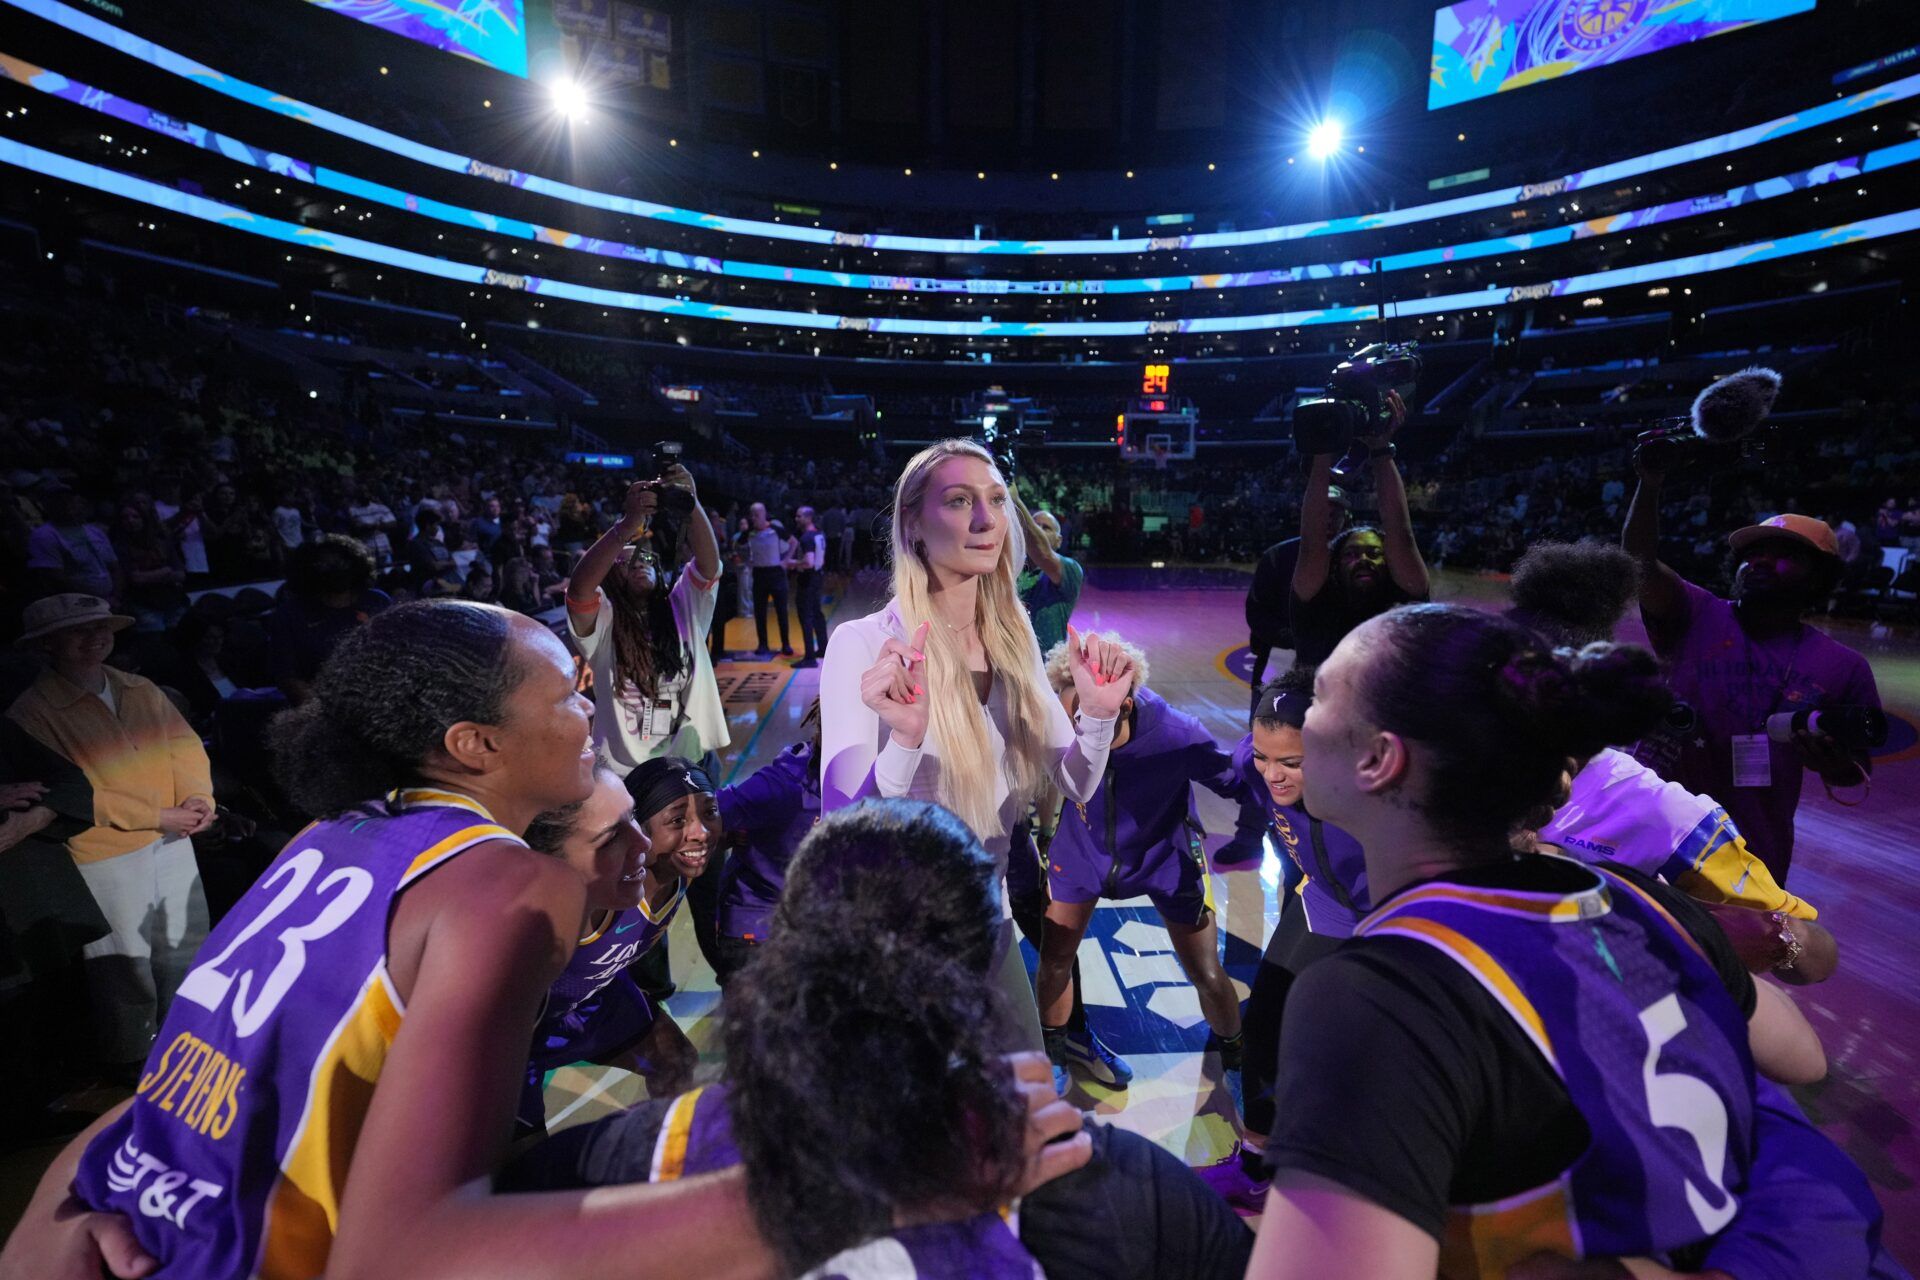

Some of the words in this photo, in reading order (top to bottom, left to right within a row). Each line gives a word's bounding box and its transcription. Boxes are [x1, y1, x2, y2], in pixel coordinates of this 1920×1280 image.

[1571, 21, 1635, 48] SPARKS
[1884, 48, 1917, 66] ULTRA
[1143, 375, 1167, 393] 24
[1564, 836, 1616, 856] RAMS
[175, 848, 373, 1038] 23
[590, 940, 643, 965] LOS
[136, 1031, 246, 1140] STEVENS
[1638, 993, 1738, 1236] 5
